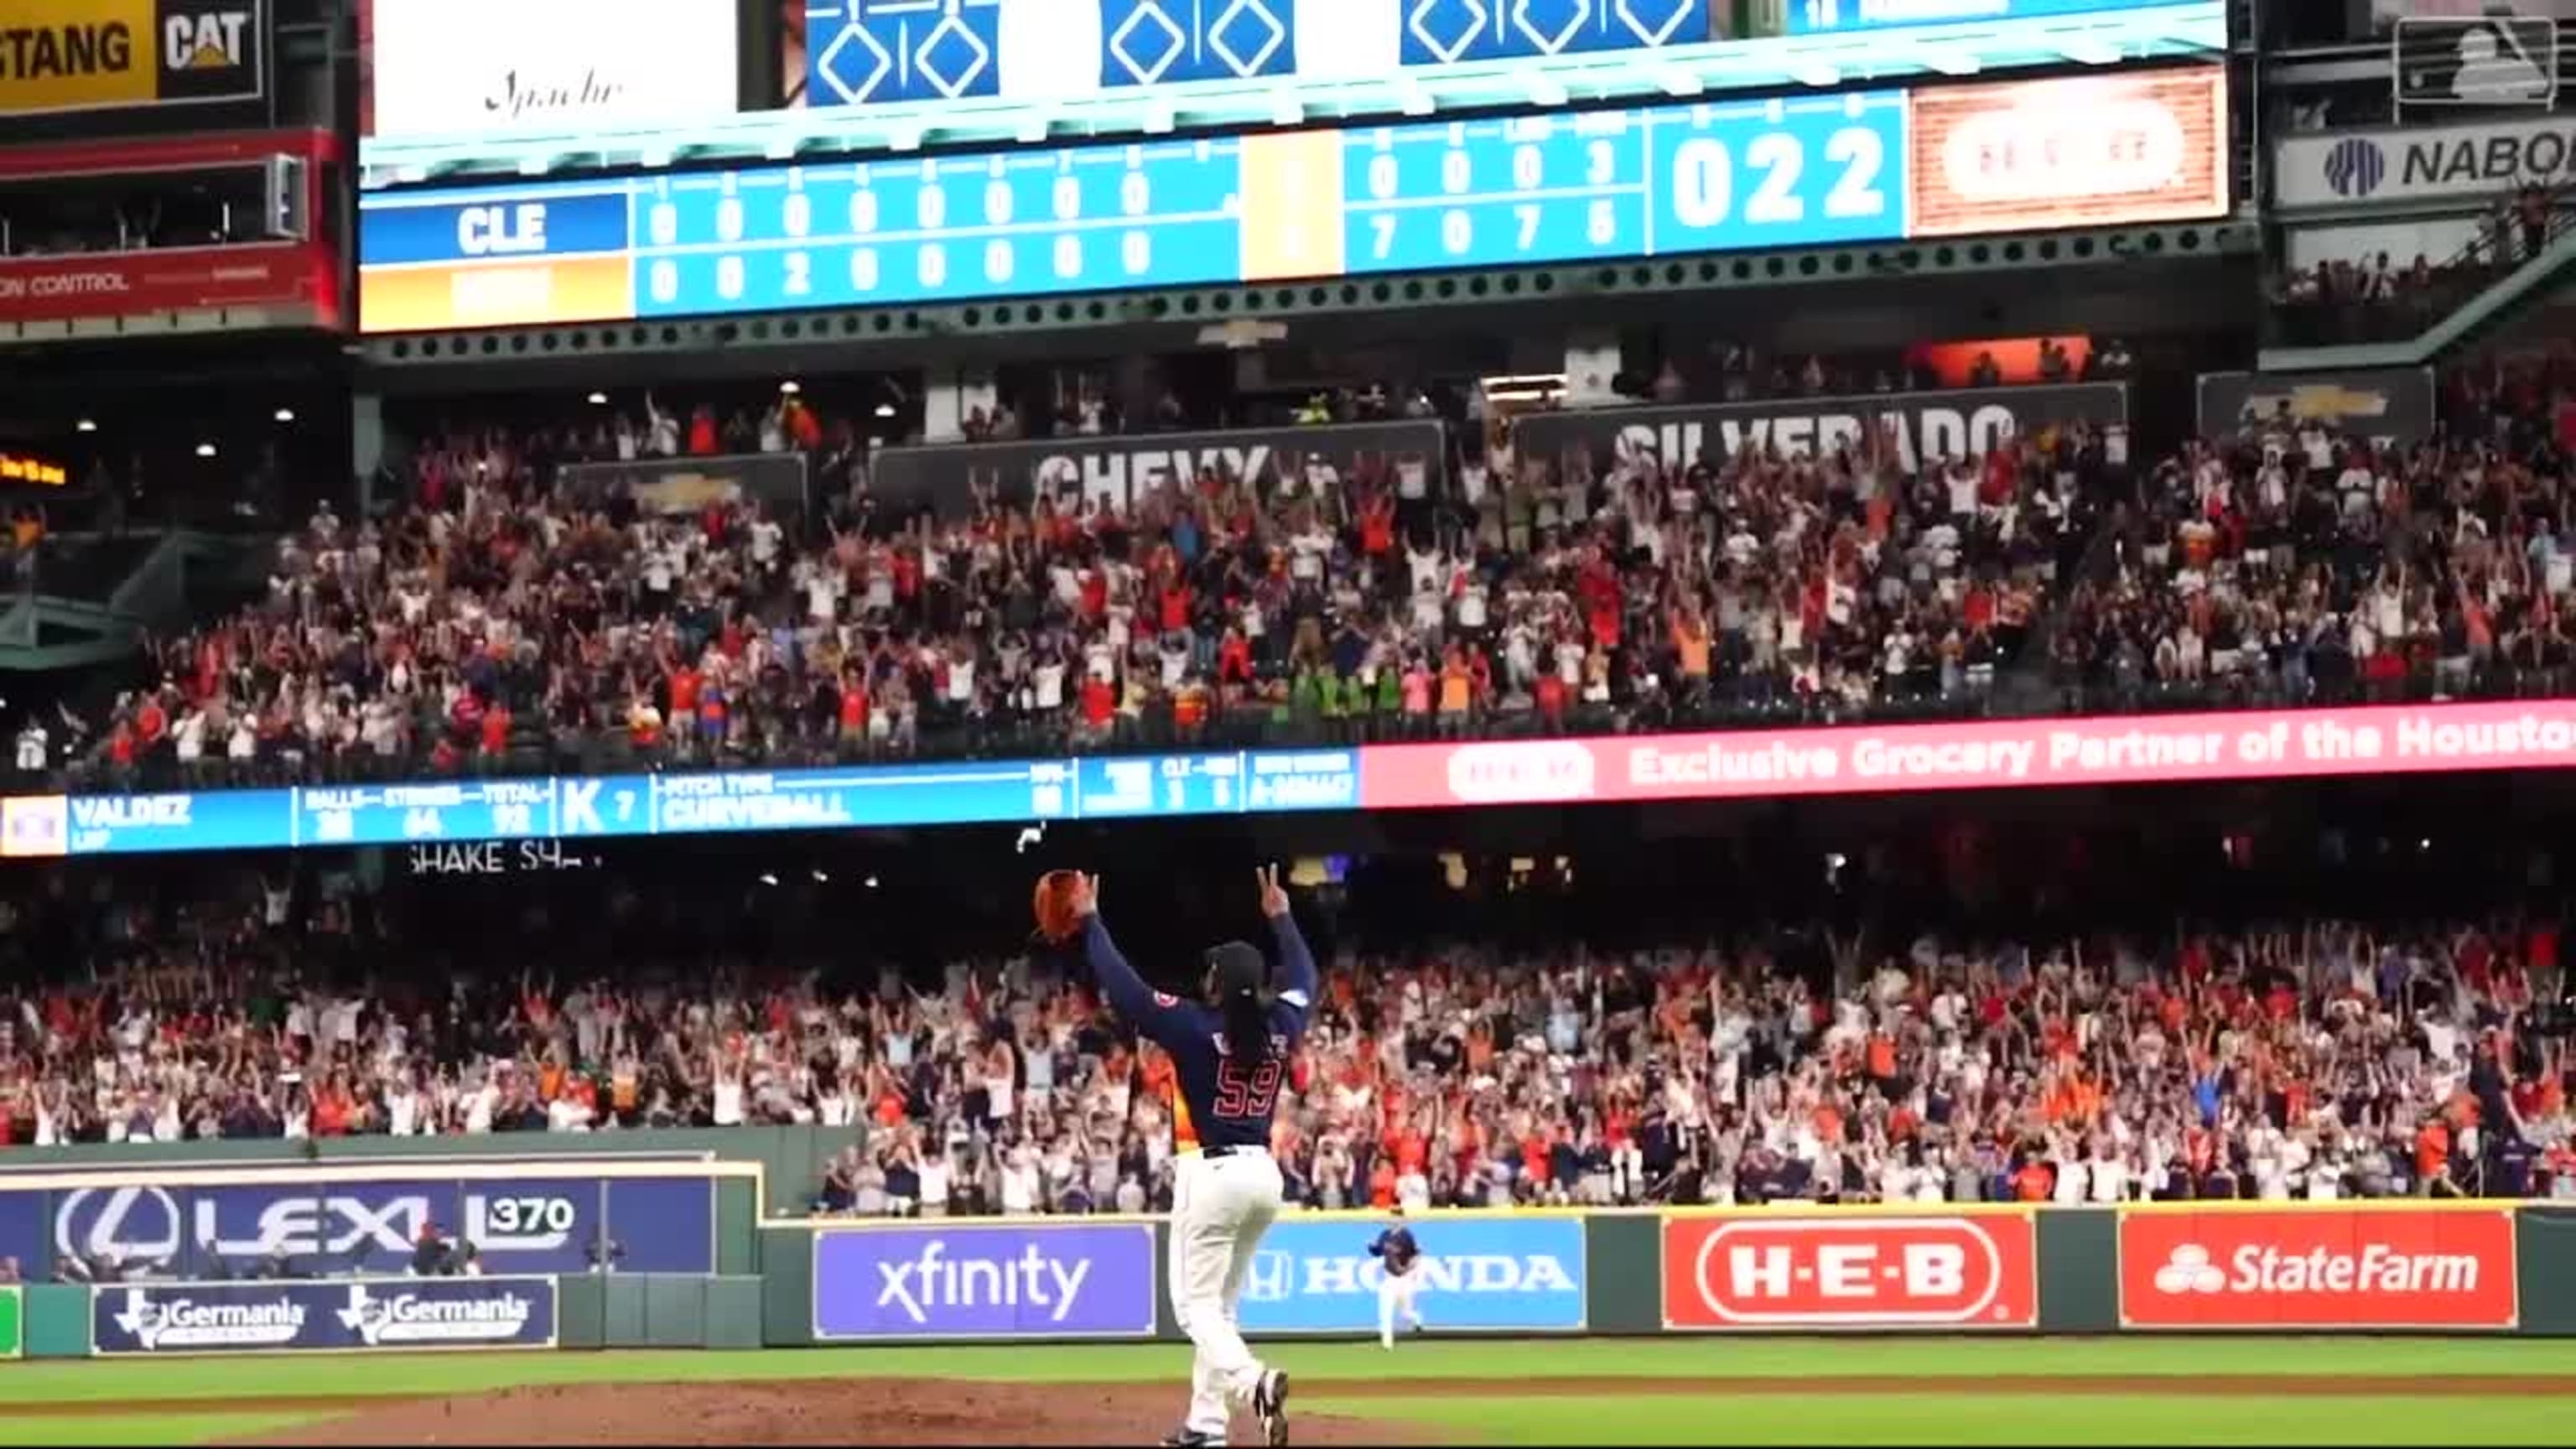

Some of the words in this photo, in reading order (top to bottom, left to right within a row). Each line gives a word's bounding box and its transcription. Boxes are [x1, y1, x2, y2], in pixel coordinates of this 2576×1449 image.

[0, 22, 130, 78] TANG
[165, 13, 247, 68] CAT
[2402, 131, 2576, 184] NABO
[458, 203, 548, 256] CLE
[31, 273, 129, 295] CONTROL
[1036, 446, 1270, 515] CHEVY
[1629, 741, 1837, 785] Exclusive
[1852, 738, 2036, 777] Grocery
[2049, 727, 2222, 771] Partner
[2237, 719, 2288, 761] of
[2302, 718, 2381, 759] the
[2397, 714, 2576, 756] Housto
[72, 795, 192, 828] VALDEZ
[563, 781, 603, 837] K
[662, 792, 854, 828] CURVEBALL
[410, 840, 505, 874] SHAKE
[1213, 1057, 1281, 1118] 59
[489, 1197, 574, 1231] 370
[877, 1241, 1091, 1322] xfinity
[1730, 1244, 1965, 1297] H-E-B
[169, 1296, 305, 1327] Germania
[393, 1291, 529, 1322] Germania
